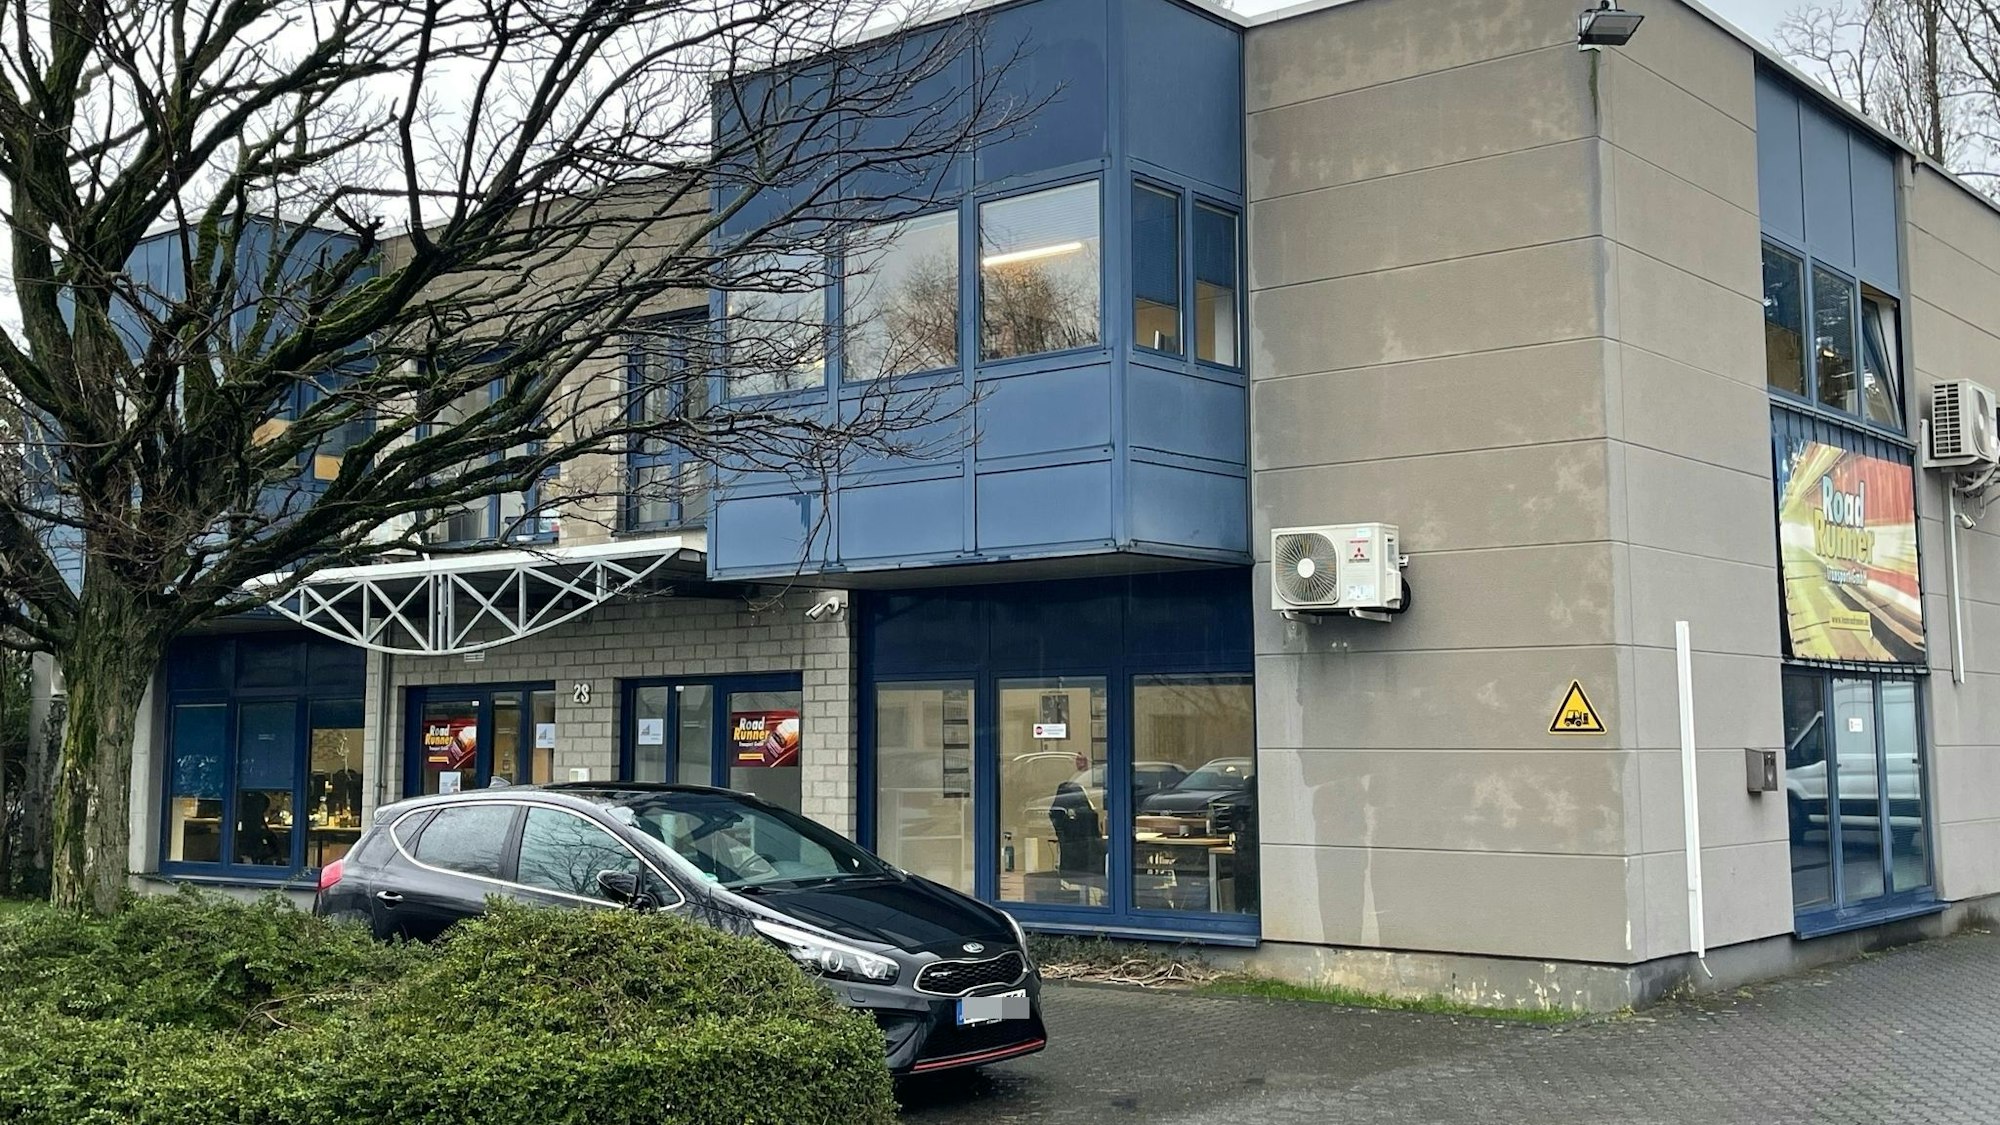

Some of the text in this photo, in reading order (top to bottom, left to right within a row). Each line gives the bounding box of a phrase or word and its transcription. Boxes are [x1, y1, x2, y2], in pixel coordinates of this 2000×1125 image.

[1822, 474, 1865, 528] Road
[1813, 507, 1875, 564] Runner
[429, 724, 450, 736] Road
[740, 716, 765, 730] Road
[425, 733, 453, 746] Runner
[733, 727, 770, 741] Runner
